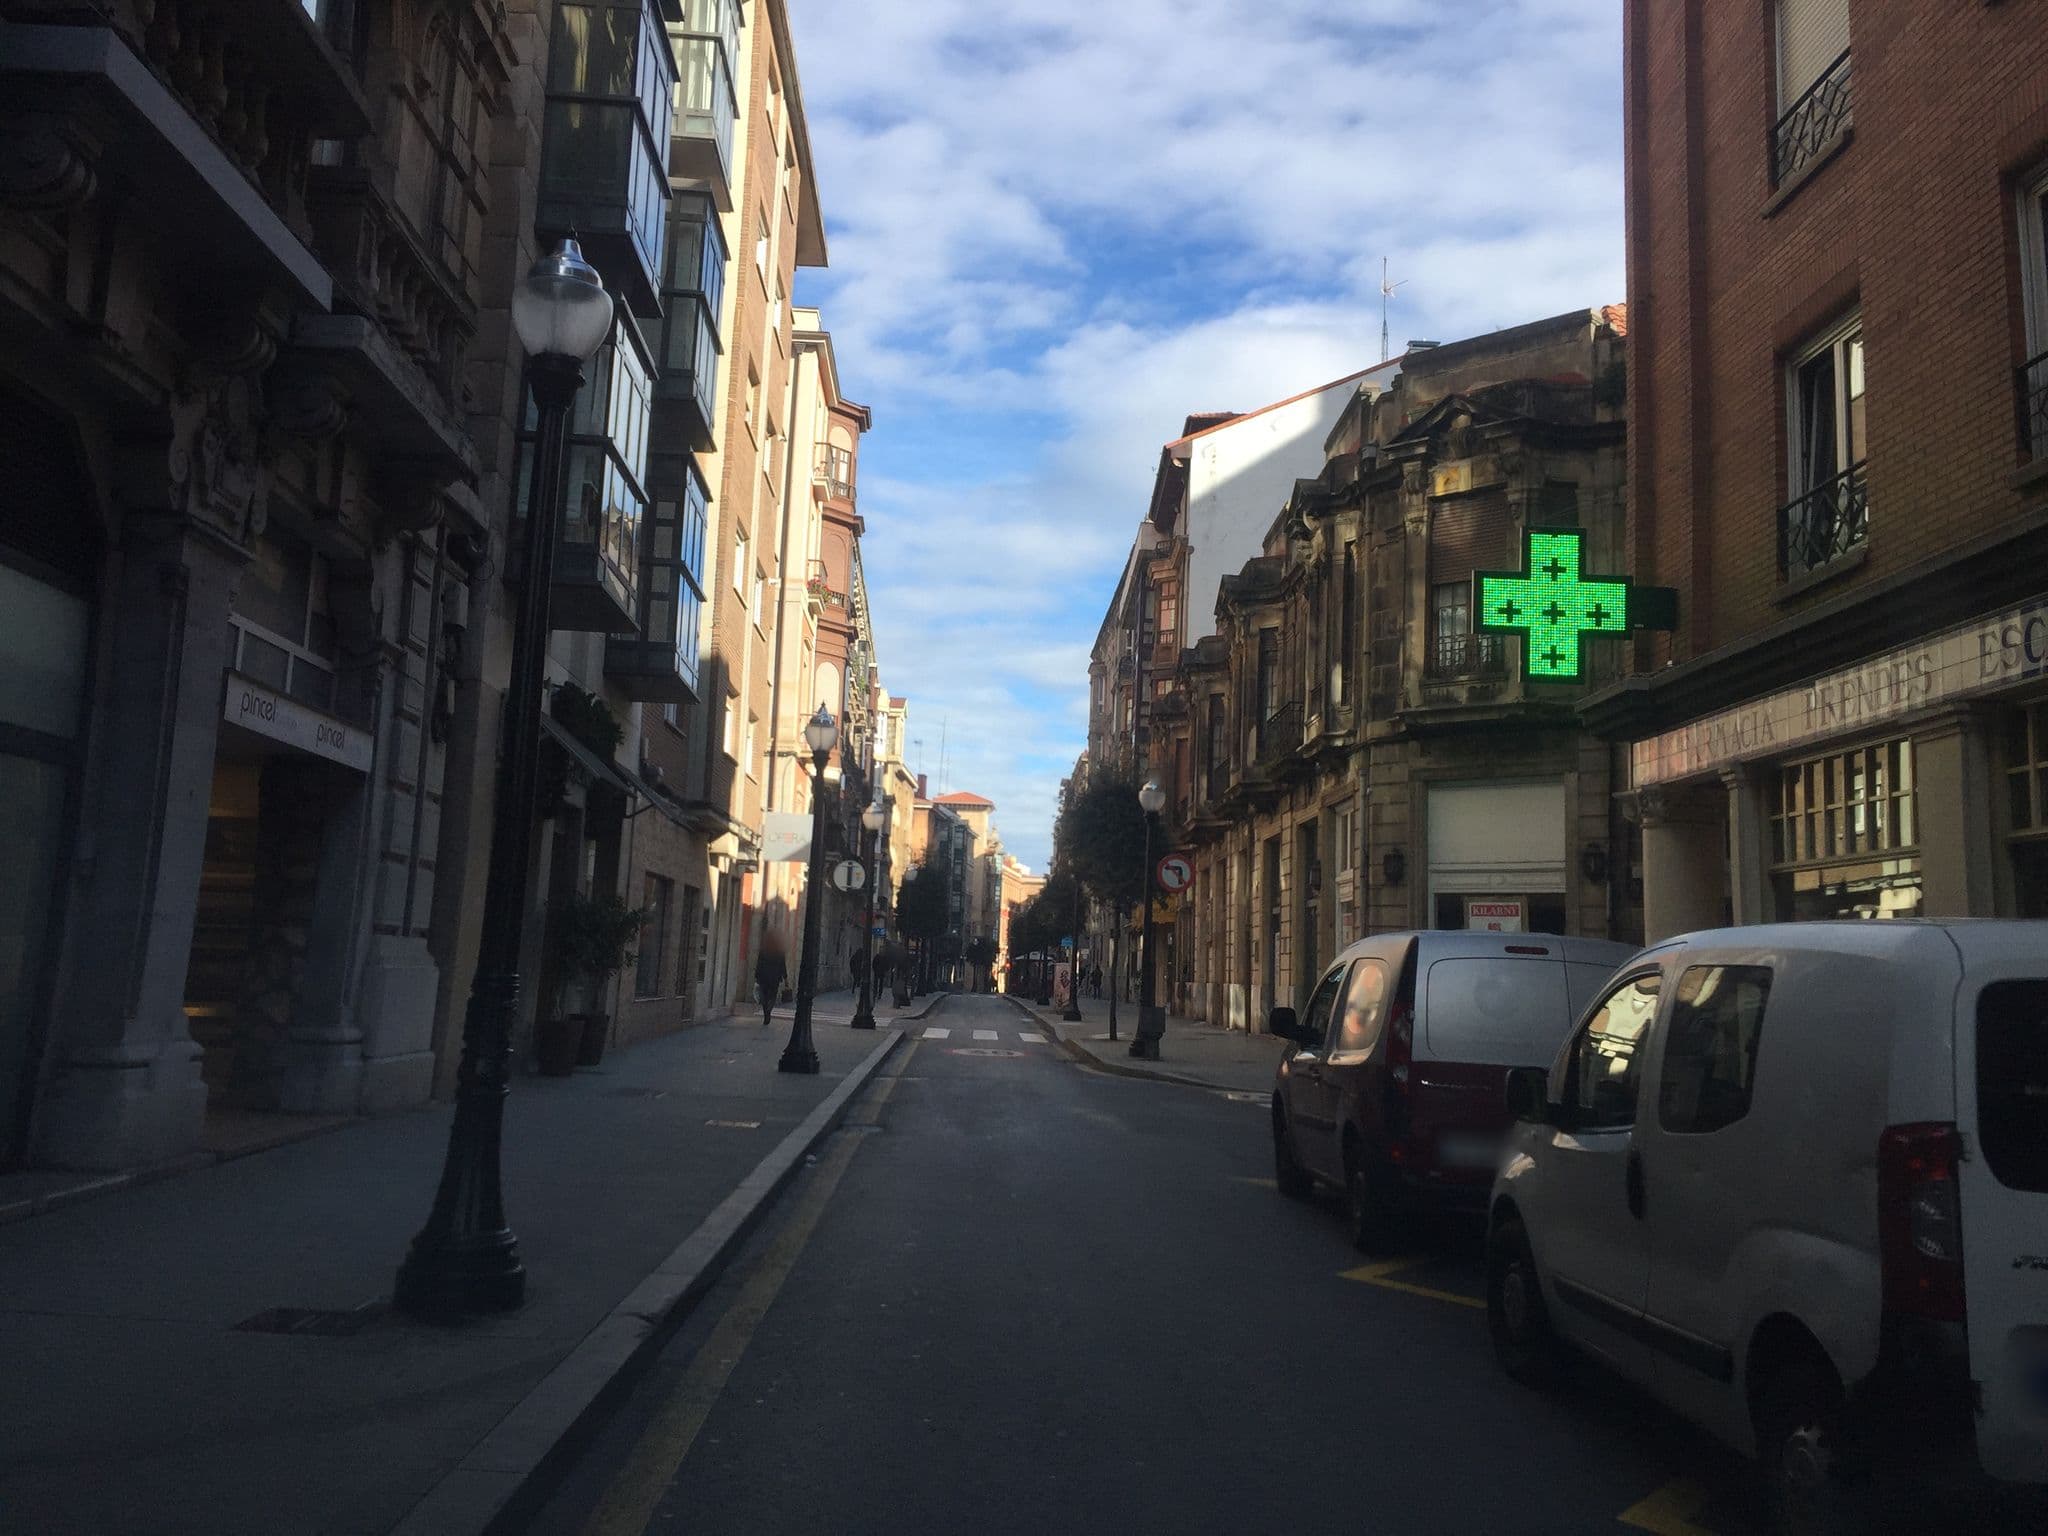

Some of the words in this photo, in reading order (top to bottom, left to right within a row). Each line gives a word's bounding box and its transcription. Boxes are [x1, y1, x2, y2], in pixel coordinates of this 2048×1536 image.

[240, 688, 278, 723] pincel
[315, 721, 346, 752] pincel
[1685, 711, 1777, 768] RMACIA
[1803, 653, 1933, 730] PRENDES
